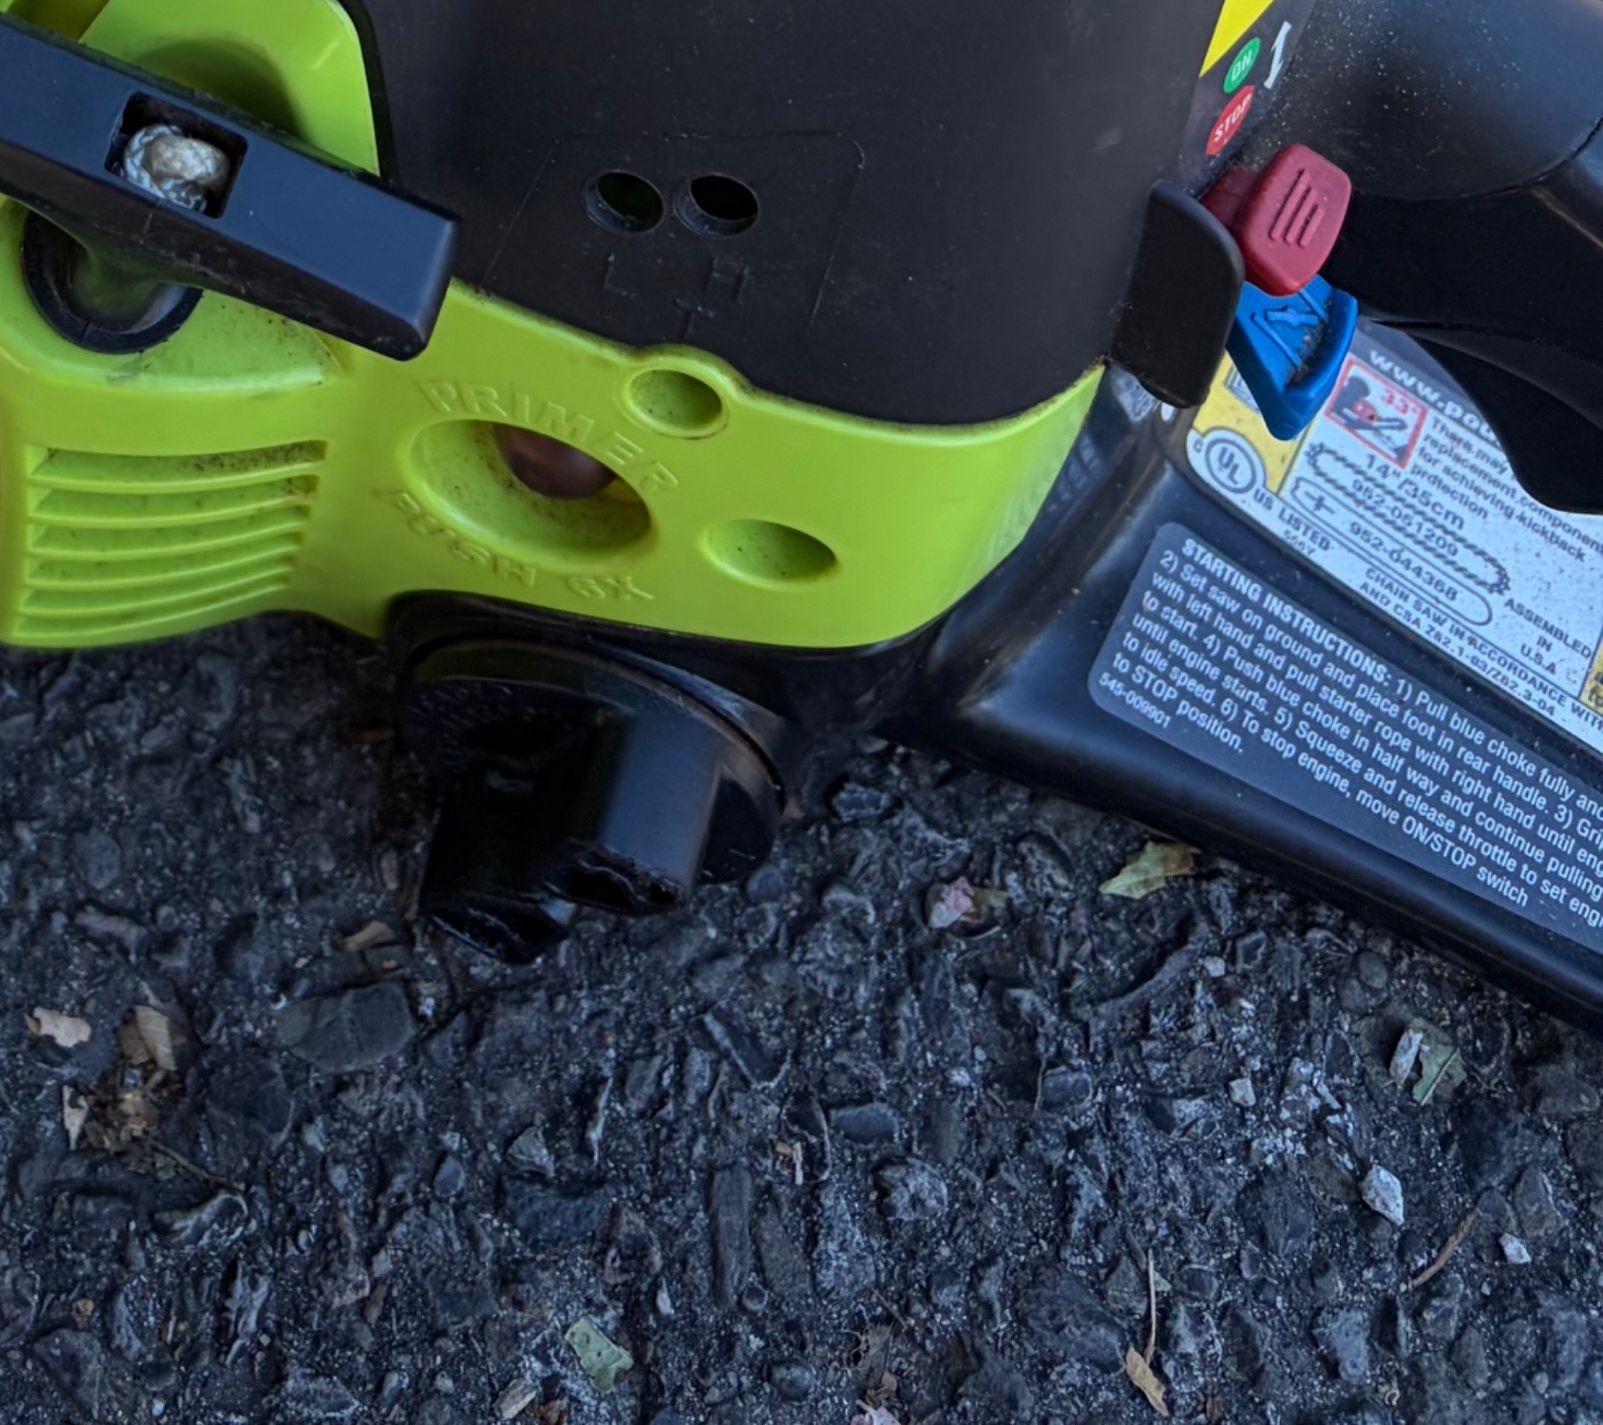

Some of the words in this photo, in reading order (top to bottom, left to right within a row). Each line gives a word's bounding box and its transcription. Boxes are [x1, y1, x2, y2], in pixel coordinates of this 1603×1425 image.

[1213, 93, 1253, 143] STOP
[1231, 50, 1253, 82] ON
[415, 379, 679, 497] PRIMER
[1422, 432, 1517, 501] replacement
[374, 486, 538, 588] PUSH
[564, 571, 656, 601] 6X
[1251, 487, 1275, 511] US
[1277, 506, 1333, 551] LISTED
[1416, 445, 1441, 469] for
[1440, 462, 1516, 520] achieving
[1515, 509, 1586, 564] kickback
[1180, 537, 1264, 603] STARTING
[1261, 591, 1393, 688] INSTRUCTIONS:
[1393, 676, 1414, 702] 1)
[1414, 689, 1449, 722] Pull
[1448, 710, 1487, 746] blue
[1486, 734, 1538, 778] choke
[1536, 765, 1575, 804] fully
[1364, 566, 1410, 603] CHAIN
[1411, 598, 1446, 628] SAW
[1448, 623, 1466, 640] IN
[1464, 634, 1568, 707] ACCORDANCE
[1504, 595, 1592, 660] ASSEMBLED
[1535, 635, 1553, 652] IN
[1097, 670, 1172, 729] 545-009901
[1110, 650, 1132, 675] to
[1130, 664, 1178, 706] STOP
[1175, 695, 1249, 756] position.
[1139, 588, 1161, 613] to
[1159, 603, 1202, 642] start.
[1199, 630, 1222, 658] 4)
[1222, 644, 1266, 684] Push
[1264, 673, 1302, 708] blue
[1301, 697, 1353, 741] choke
[1351, 729, 1371, 753] in
[1370, 741, 1405, 775] half
[1402, 764, 1439, 799] way
[1440, 785, 1474, 818] and
[1473, 806, 1547, 865] continue
[1545, 852, 1603, 904] pulling
[1149, 570, 1186, 604] with
[1184, 593, 1213, 622] left
[1211, 611, 1255, 650] hand
[1253, 639, 1286, 671] and
[1285, 661, 1318, 693] pull
[1318, 682, 1373, 728] starter
[1371, 718, 1412, 756] rope
[1412, 741, 1451, 777] with
[1450, 766, 1492, 805] right
[1492, 791, 1536, 831] hand
[1536, 818, 1576, 856] until
[1158, 548, 1180, 574] 2)
[1179, 561, 1210, 593] Set
[1206, 584, 1240, 614] saw
[1240, 606, 1264, 630] on
[1262, 620, 1323, 671] ground
[1323, 658, 1356, 690] and
[1354, 679, 1401, 721] place
[1400, 707, 1438, 742] foot
[1436, 729, 1456, 753] in
[1455, 744, 1490, 775] rear
[1491, 763, 1554, 815] handle.
[1551, 802, 1575, 831] 3)
[1121, 630, 1141, 653] to
[1139, 642, 1170, 673] idle
[1166, 663, 1220, 710] speed.
[1217, 696, 1239, 723] 6)
[1237, 708, 1262, 735] To
[1258, 724, 1297, 762] stop
[1295, 748, 1356, 800] engine,
[1354, 787, 1400, 827] move
[1400, 814, 1476, 873] ON/STOP
[1476, 861, 1530, 908] switch
[1130, 610, 1169, 646] until
[1166, 635, 1222, 684] engine
[1221, 673, 1273, 716] starts.
[1271, 705, 1295, 733] 5)
[1292, 718, 1364, 777] Squeeze
[1363, 764, 1397, 797] and
[1397, 785, 1457, 834] release
[1456, 822, 1520, 874] throttle
[1517, 862, 1539, 886] to
[1539, 875, 1569, 905] set
